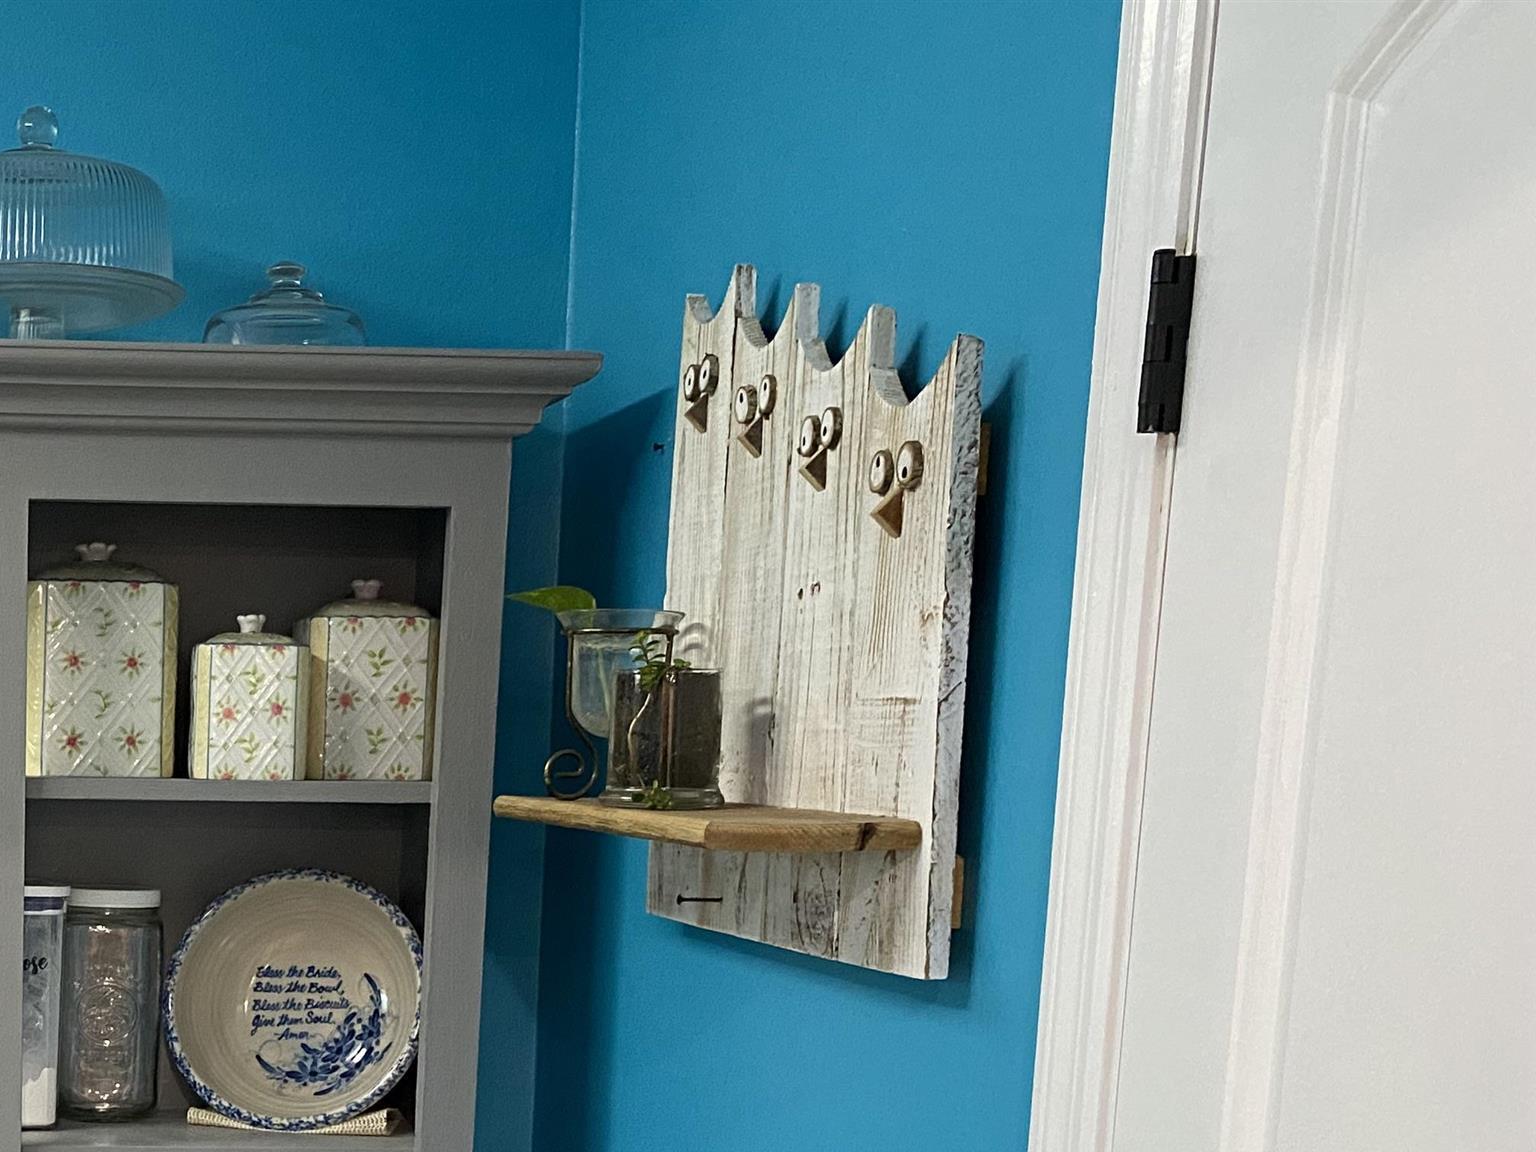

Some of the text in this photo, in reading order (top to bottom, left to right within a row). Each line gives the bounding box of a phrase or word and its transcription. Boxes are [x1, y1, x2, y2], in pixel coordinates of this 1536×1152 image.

[286, 966, 304, 978] the
[253, 981, 283, 993] Bless
[285, 981, 305, 993] the
[252, 999, 281, 1011] Bless
[282, 998, 302, 1010] the
